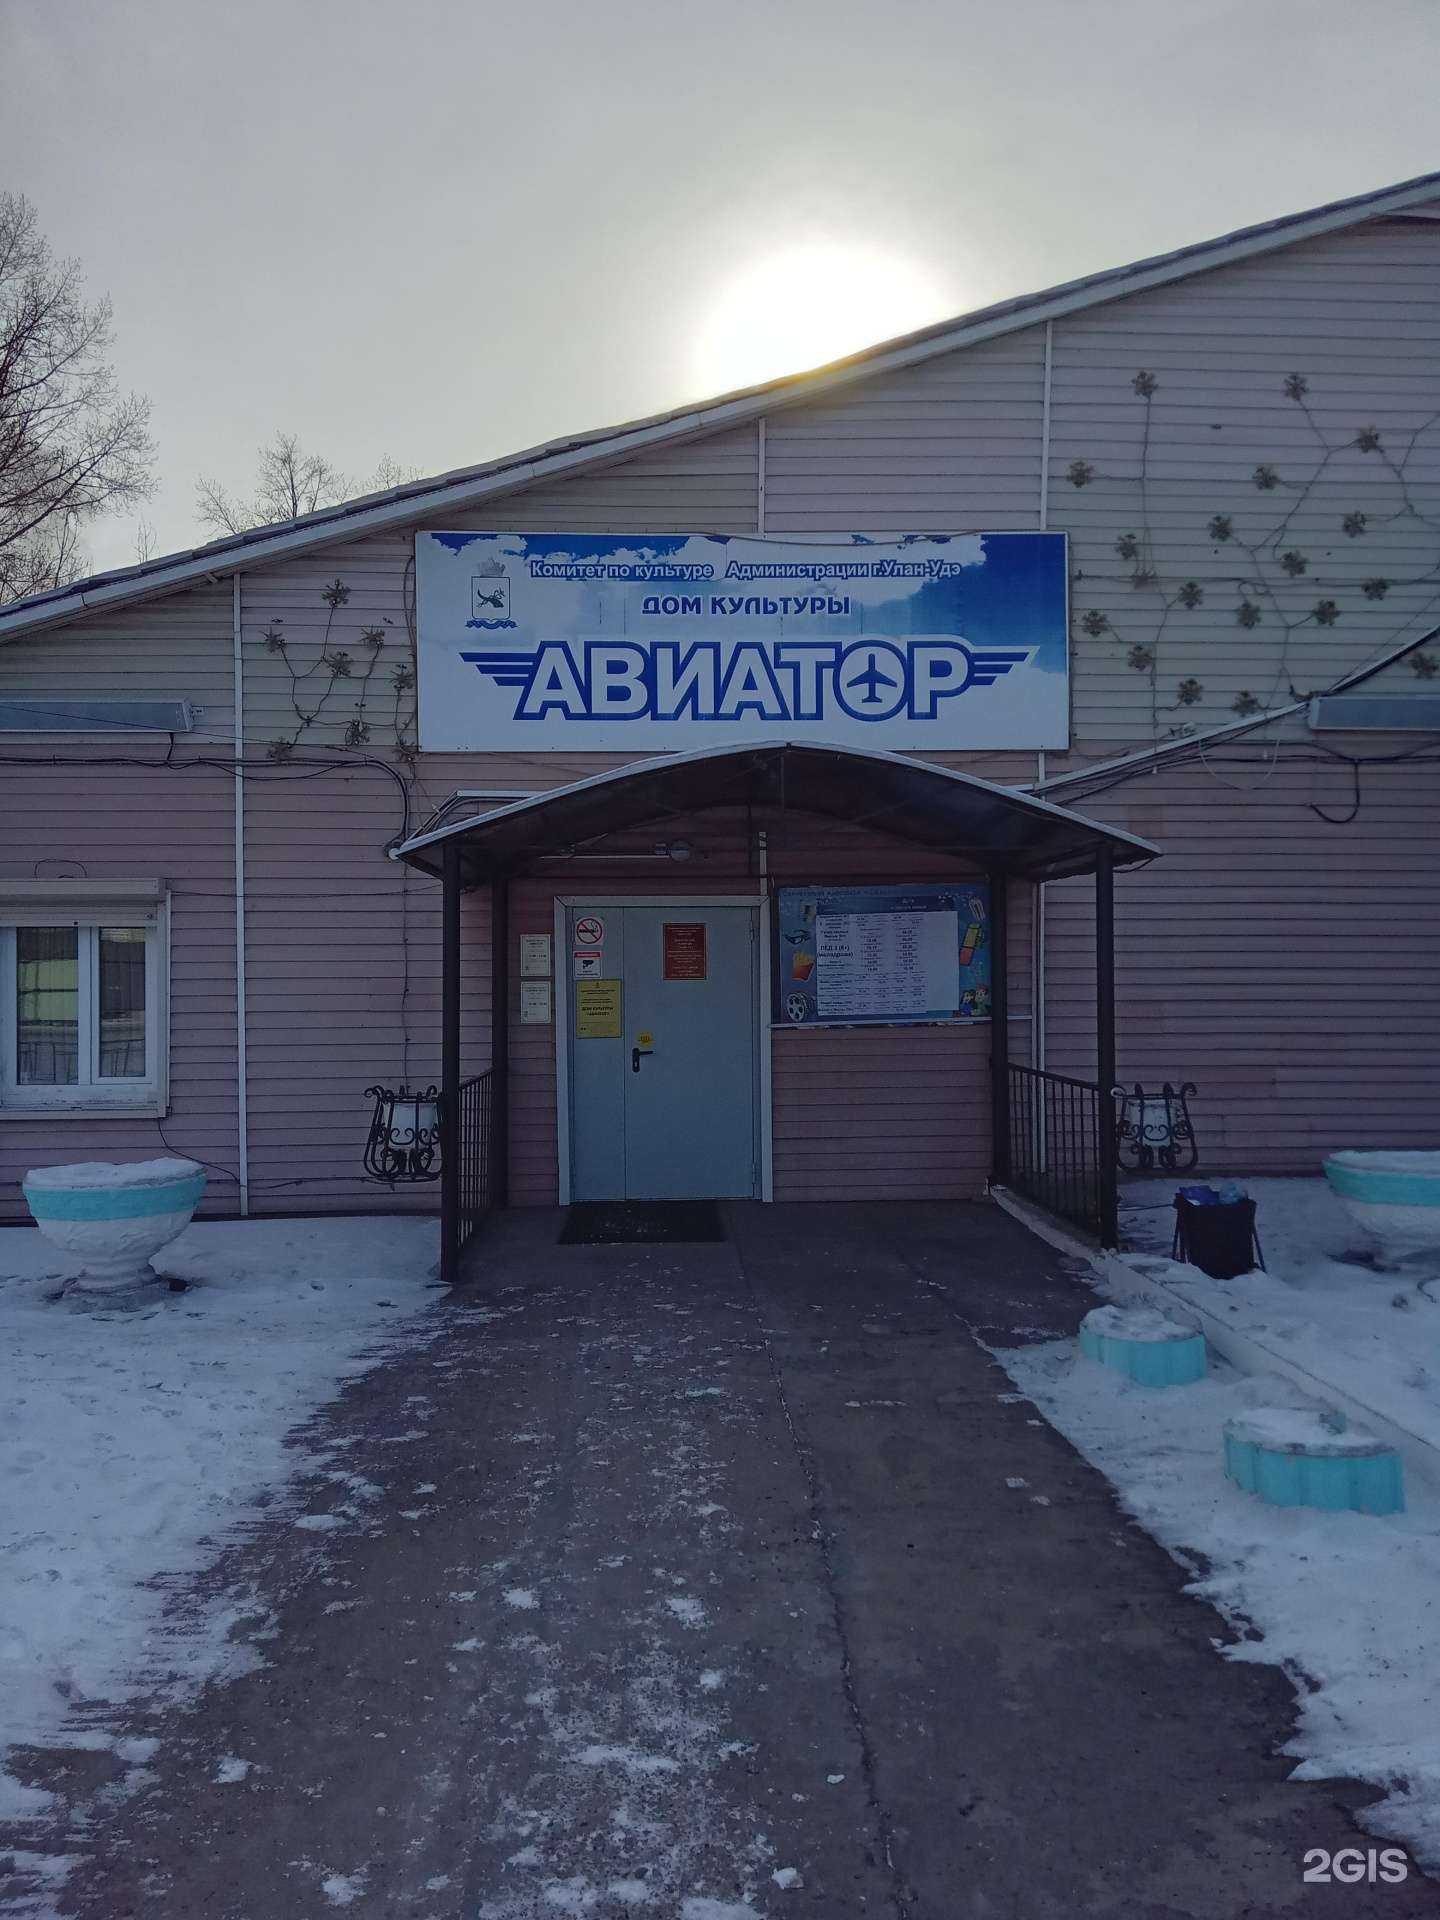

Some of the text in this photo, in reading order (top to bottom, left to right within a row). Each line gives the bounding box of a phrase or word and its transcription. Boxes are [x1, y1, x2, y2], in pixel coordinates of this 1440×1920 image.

[531, 561, 606, 578] Комитет
[608, 564, 631, 578] по
[634, 564, 715, 581] культуре
[725, 560, 869, 580] Администрации
[641, 596, 850, 615] ДОМ КУЛЬТУРЫ
[513, 640, 974, 722] АВИАТОР
